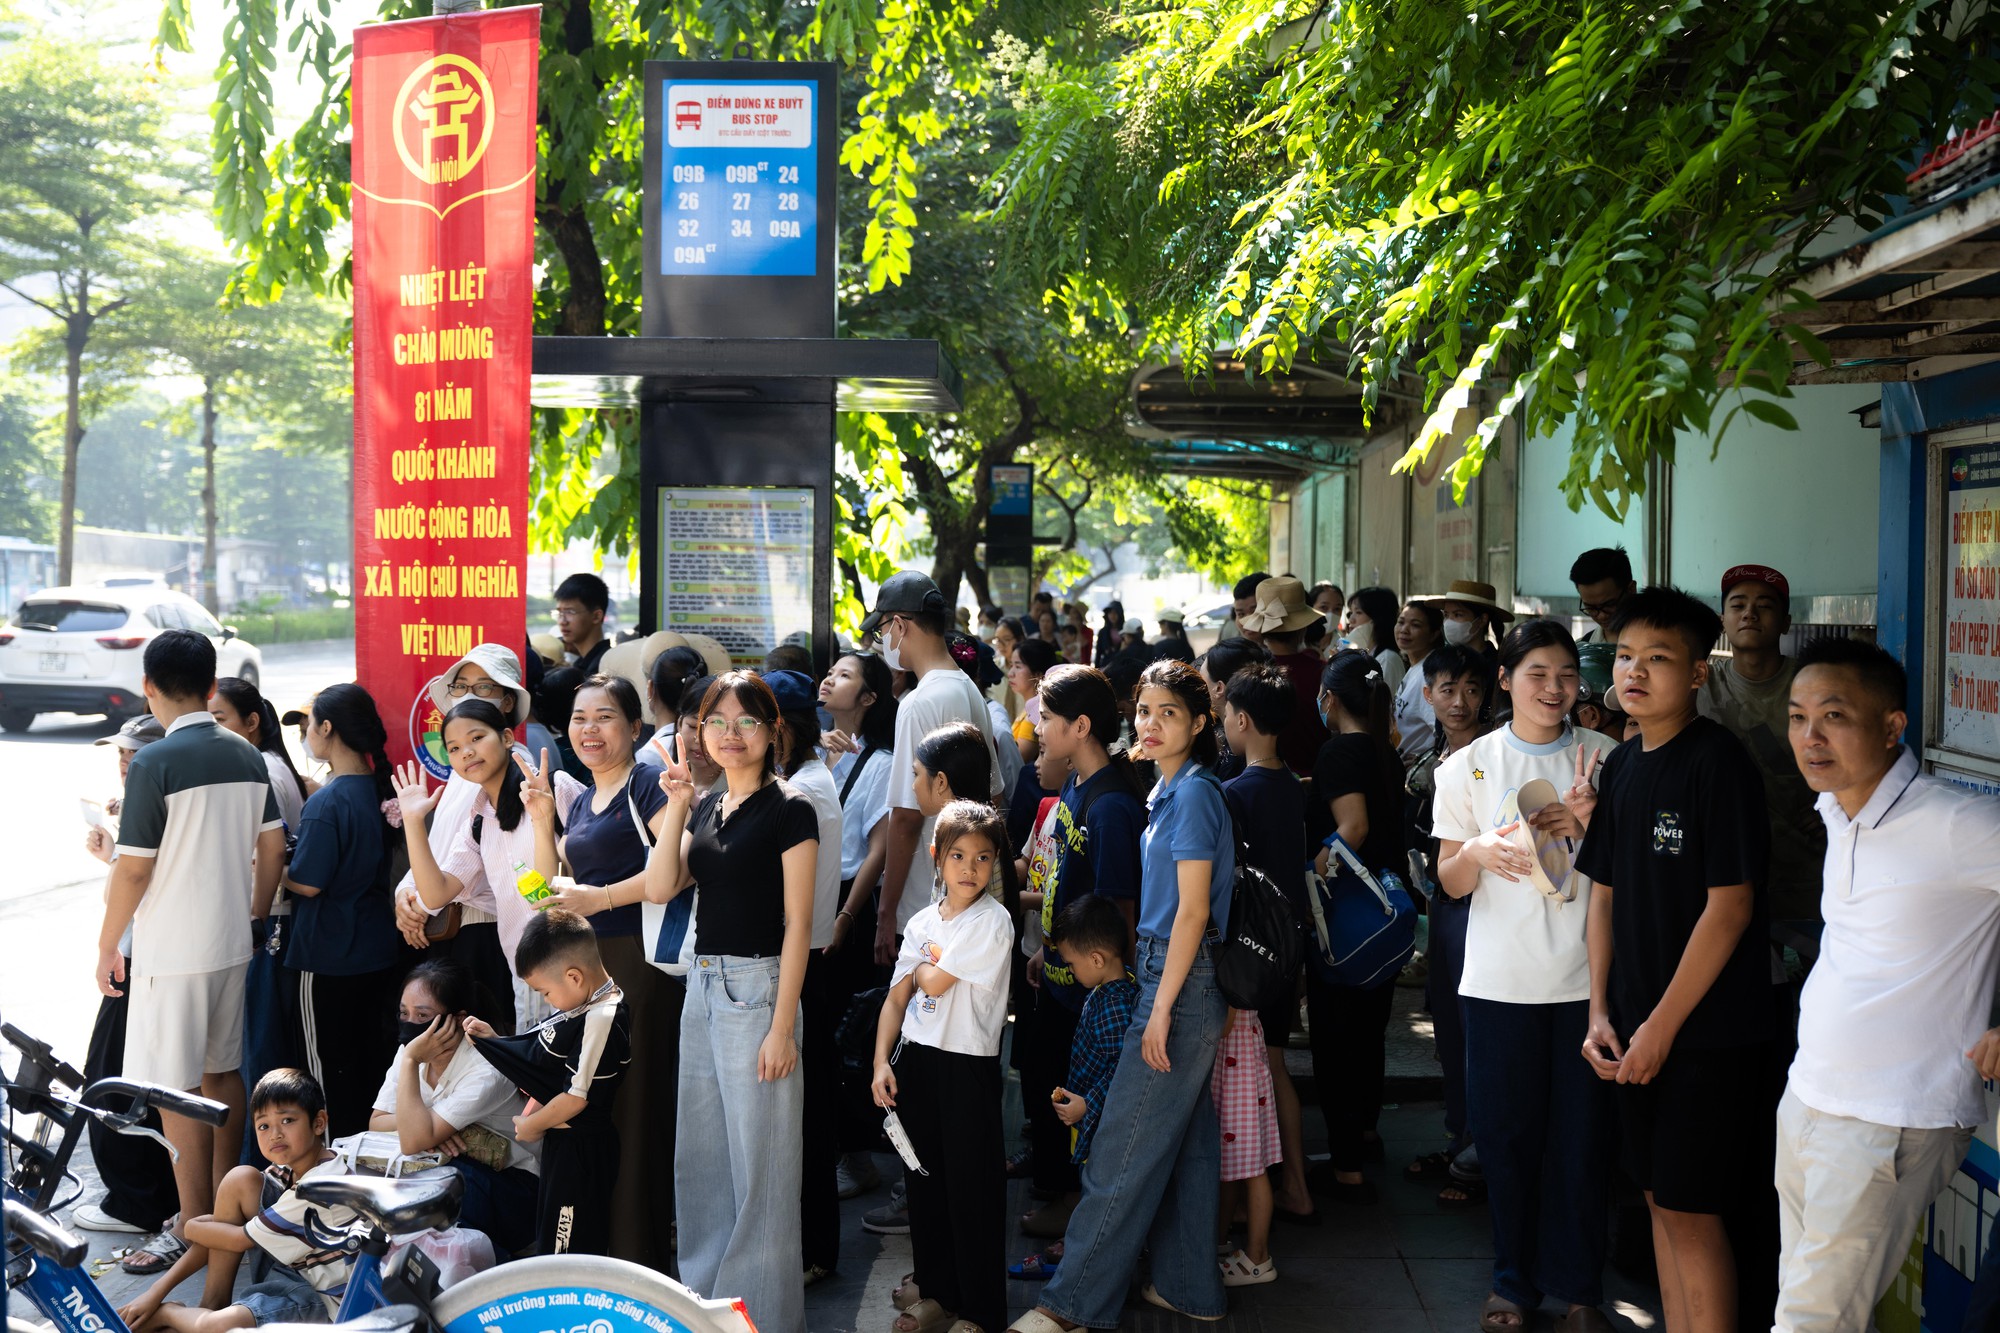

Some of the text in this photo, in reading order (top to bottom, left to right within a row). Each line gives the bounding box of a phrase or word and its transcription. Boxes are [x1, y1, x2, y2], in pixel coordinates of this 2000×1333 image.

[707, 94, 804, 110] ĐIỂM DỪNG XE BUÝT
[732, 114, 778, 125] BUS STOP
[441, 155, 458, 187] NỘI
[673, 165, 705, 184] 09B
[778, 166, 799, 184] 24
[678, 192, 799, 211] 26 27 28
[678, 219, 801, 238] 32 34 09A
[400, 261, 488, 311] NHIỆT LIỆT
[393, 321, 494, 365] CHÀO MỪNG
[415, 381, 472, 423] 81 NĂM
[392, 438, 496, 485] QUỐC KHÁNH
[374, 498, 512, 546] NƯỚC CỘNG HÒA
[1953, 498, 1973, 544] ĐIỂM
[1975, 498, 1992, 544] TIẾP
[364, 555, 518, 605] XÃ HỘI CHỦ NGHĨA
[1955, 555, 1965, 599] HỒ
[1967, 563, 1978, 600] SƠ
[401, 617, 434, 663] VIỆT
[436, 624, 472, 657] NAM
[1949, 610, 1967, 654] GIẤY
[1968, 616, 1989, 656] PHÉP
[1965, 671, 1975, 710] TÔ
[1976, 679, 1999, 720] HẠNG
[1653, 826, 1683, 839] POWER
[1237, 933, 1267, 956] LOVE
[62, 1285, 115, 1333] TNG
[477, 1306, 503, 1325] Môi
[503, 1296, 546, 1316] trường
[548, 1292, 581, 1306] xanh.
[583, 1293, 614, 1310] Cuộc
[614, 1301, 645, 1322] sống
